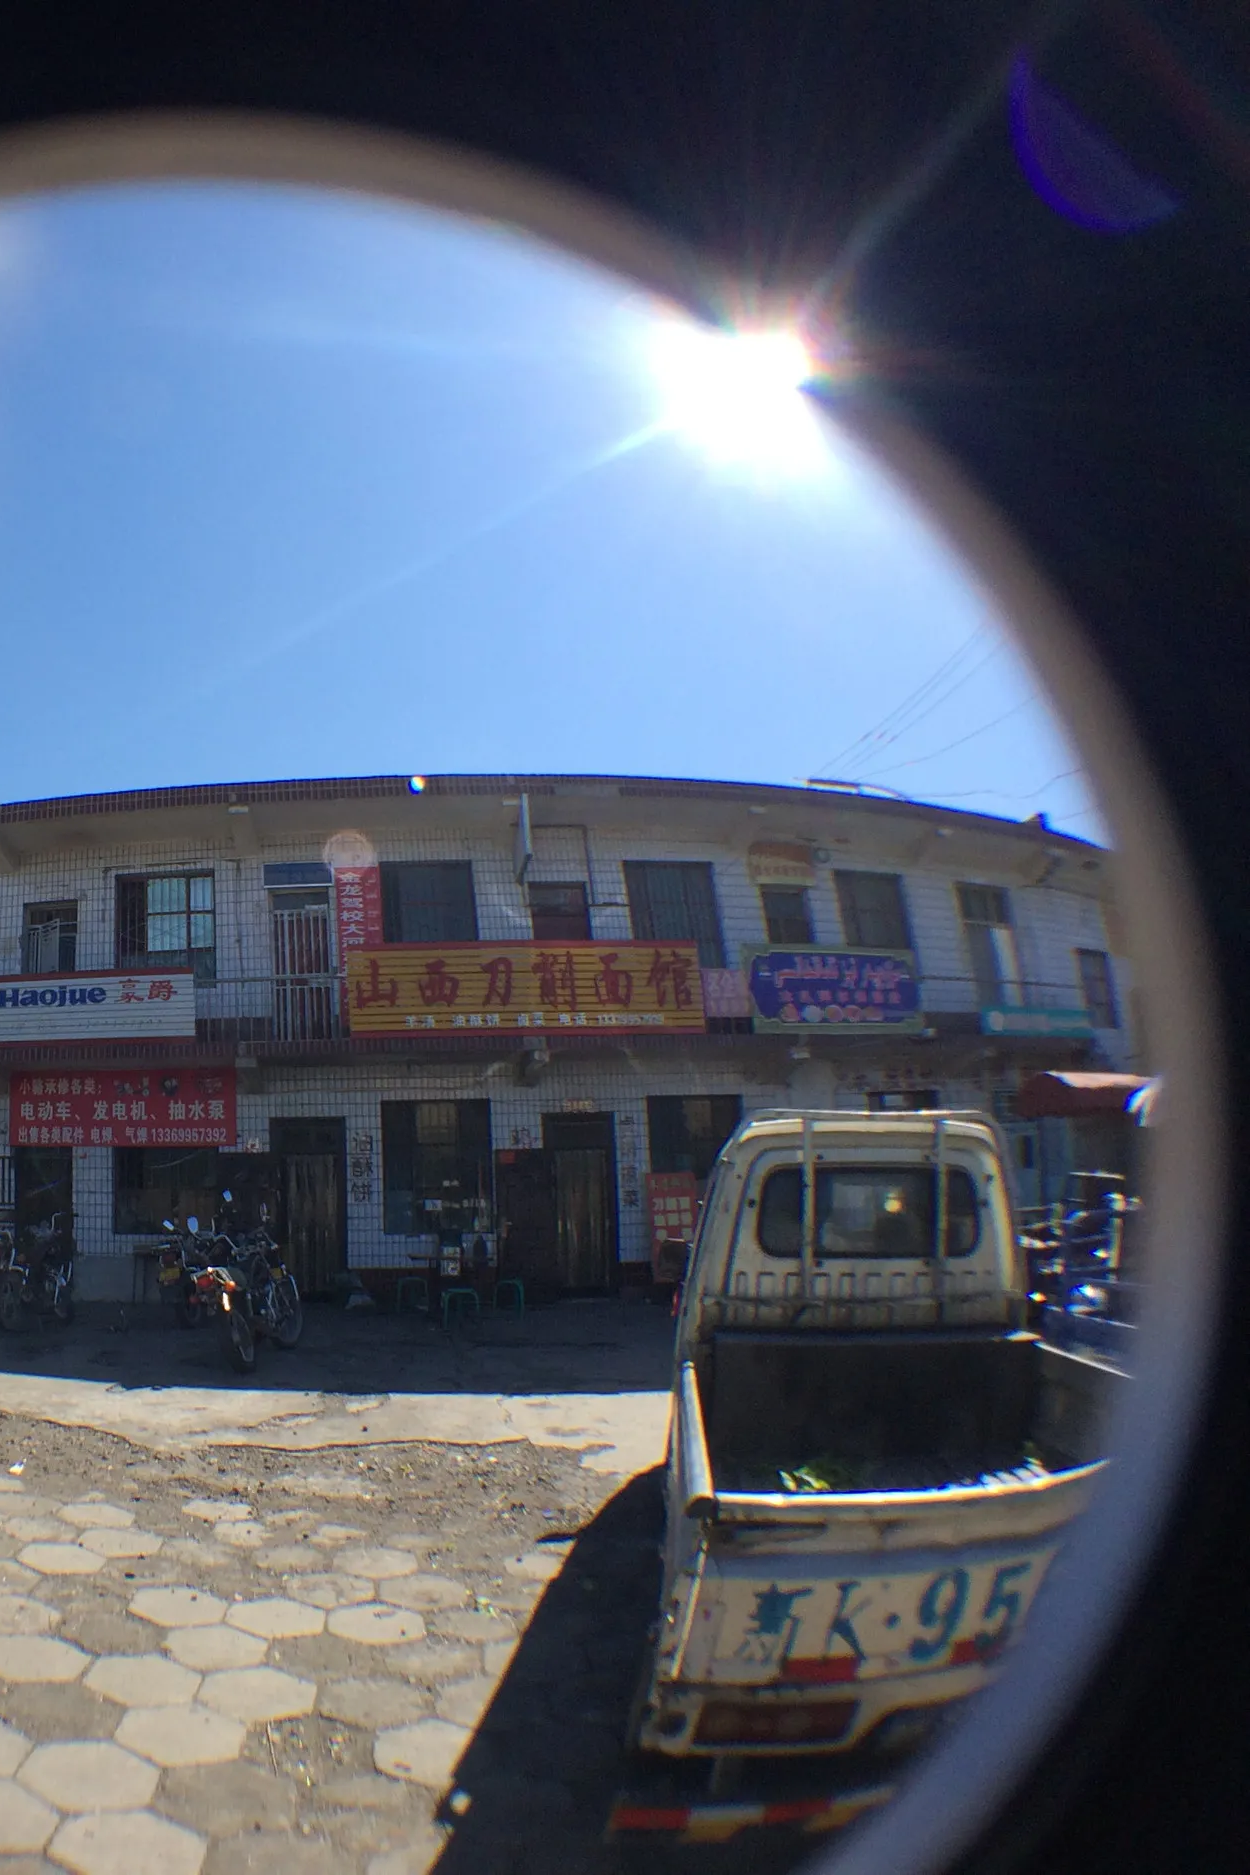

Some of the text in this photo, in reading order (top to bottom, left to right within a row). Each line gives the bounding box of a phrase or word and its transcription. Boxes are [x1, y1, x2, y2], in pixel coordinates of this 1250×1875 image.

[115, 978, 179, 1004] 豪爵
[18, 1126, 84, 1144] 出售各类配件
